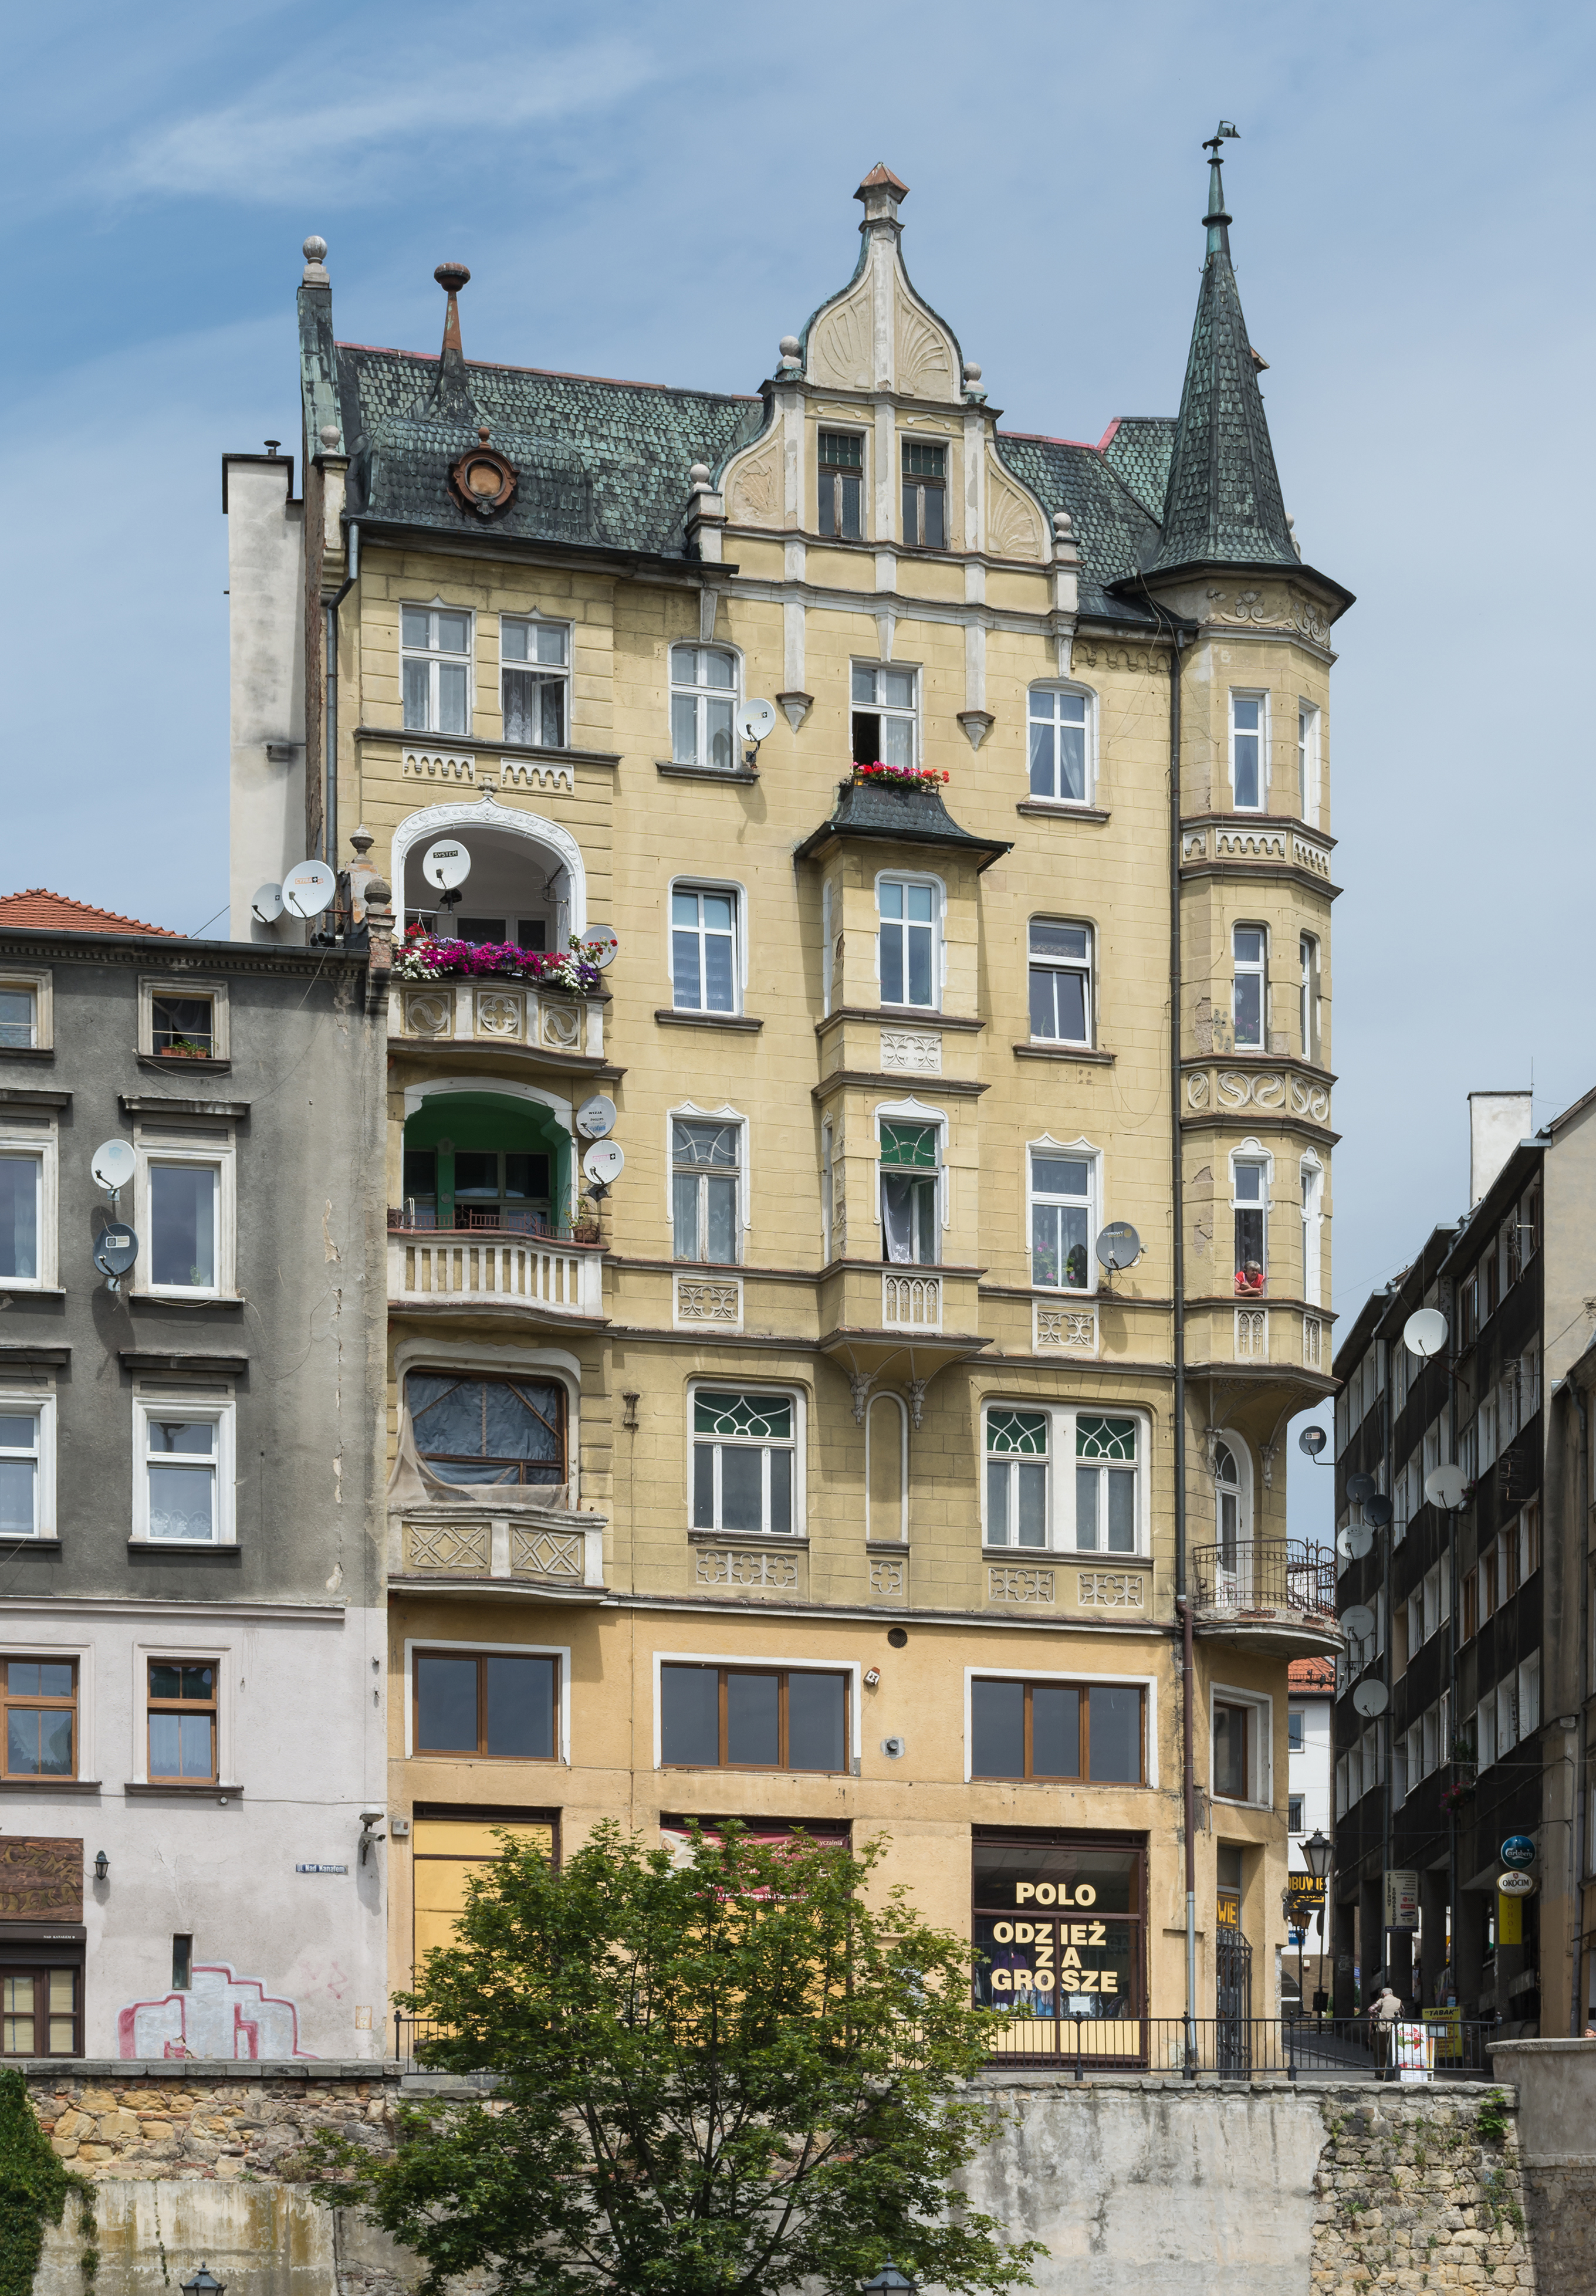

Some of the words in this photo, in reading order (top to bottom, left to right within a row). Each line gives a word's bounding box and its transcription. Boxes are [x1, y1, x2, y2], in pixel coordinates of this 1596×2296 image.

[1505, 1847, 1533, 1859] Carlsberg
[1016, 1882, 1096, 1906] POLO
[1502, 1879, 1529, 1887] OKOCIM
[1217, 1900, 1236, 1924] WIE
[993, 1920, 1107, 1946] ODZIEŻ
[1035, 1946, 1082, 1968] ZA
[991, 1969, 1118, 1993] GROSZE
